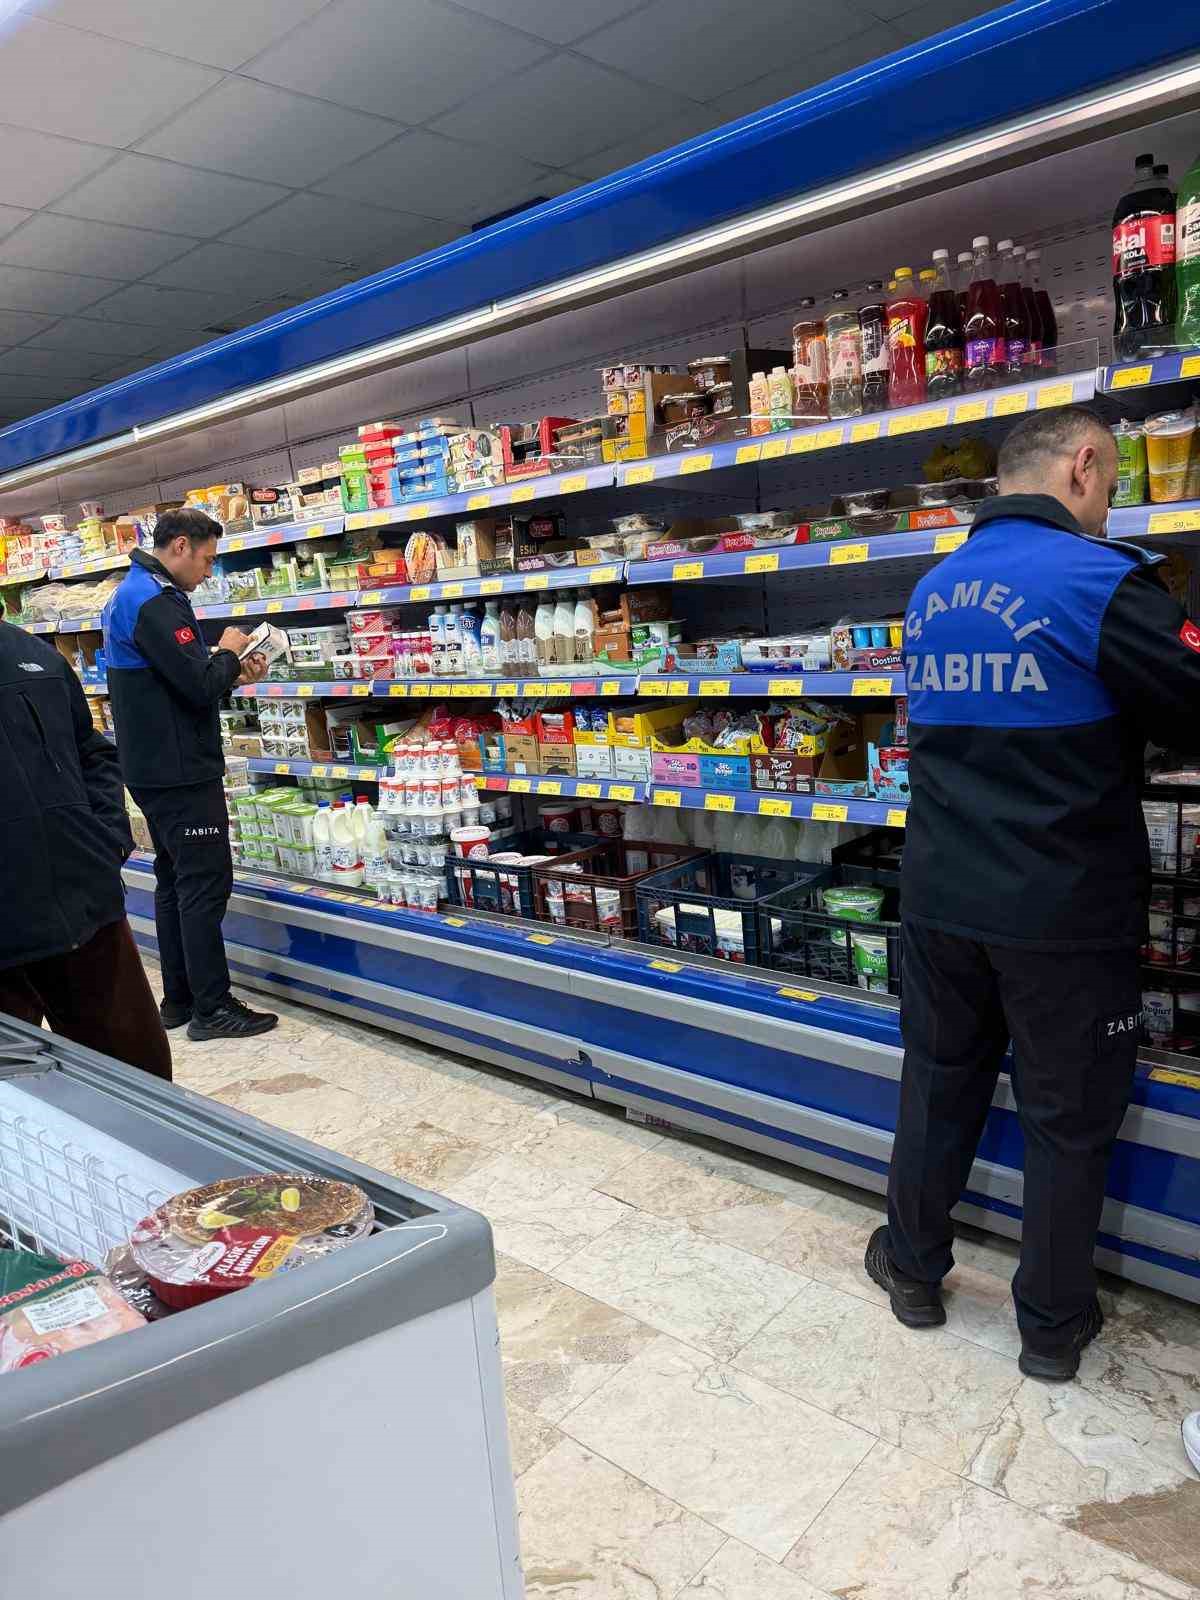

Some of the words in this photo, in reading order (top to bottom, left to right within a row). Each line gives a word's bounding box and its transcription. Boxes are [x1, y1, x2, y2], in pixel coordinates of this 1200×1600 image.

[1124, 248, 1146, 259] KOLA
[906, 580, 1051, 642] ÇAMELİ
[906, 653, 1048, 692] ZABITA
[184, 827, 220, 836] ZABITA
